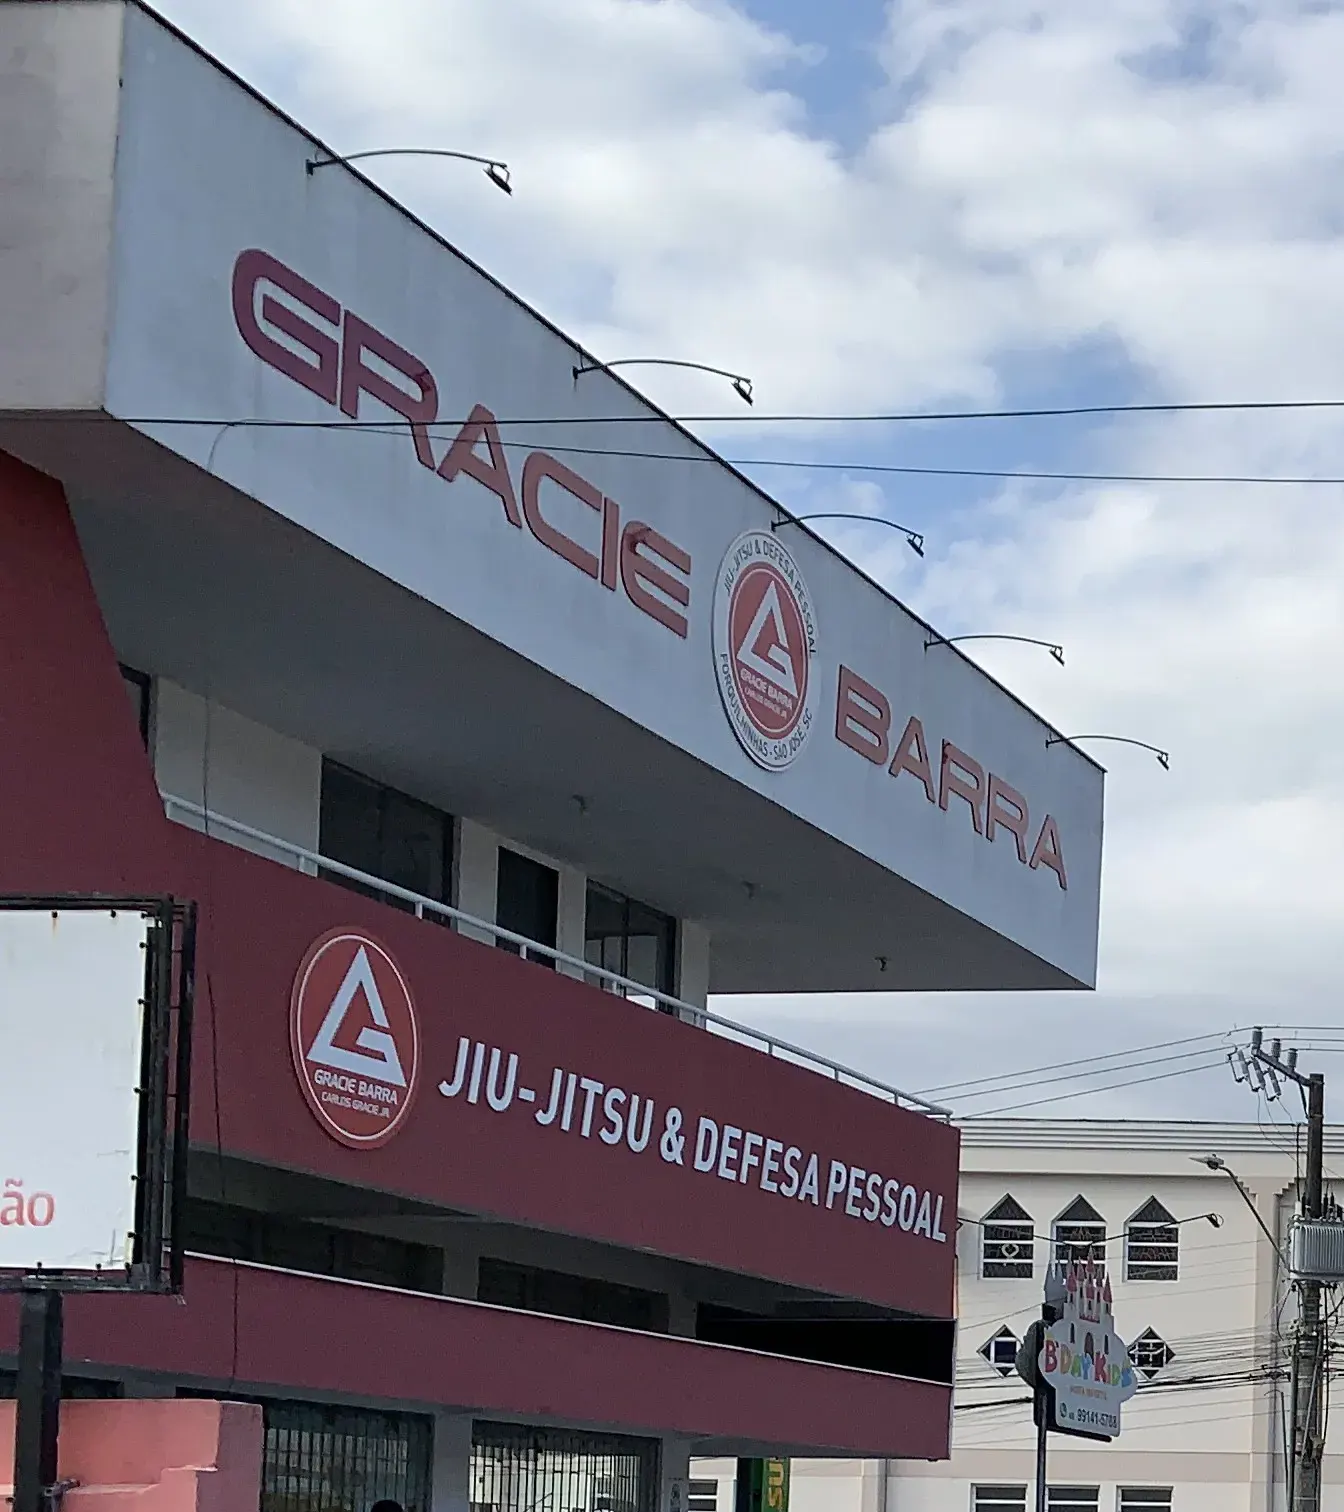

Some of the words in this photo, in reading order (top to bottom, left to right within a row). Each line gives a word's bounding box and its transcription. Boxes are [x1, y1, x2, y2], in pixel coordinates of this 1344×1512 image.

[231, 248, 692, 638] GRACIE
[834, 663, 1069, 891] BARRA
[723, 540, 753, 597] JIU-JITSU
[755, 539, 762, 556] &
[762, 540, 795, 582] DEFESA
[794, 582, 817, 654] PESSOAL
[739, 668, 766, 697] GRACIE
[774, 740, 788, 761] SÃO
[803, 707, 813, 727] SC
[313, 1068, 358, 1094] GRACIE
[357, 1080, 398, 1105] BARRA
[437, 1036, 654, 1154] JIU-JITSU
[659, 1107, 684, 1166] &
[693, 1116, 820, 1207] DEFESA
[825, 1158, 948, 1244] PESSOAL
